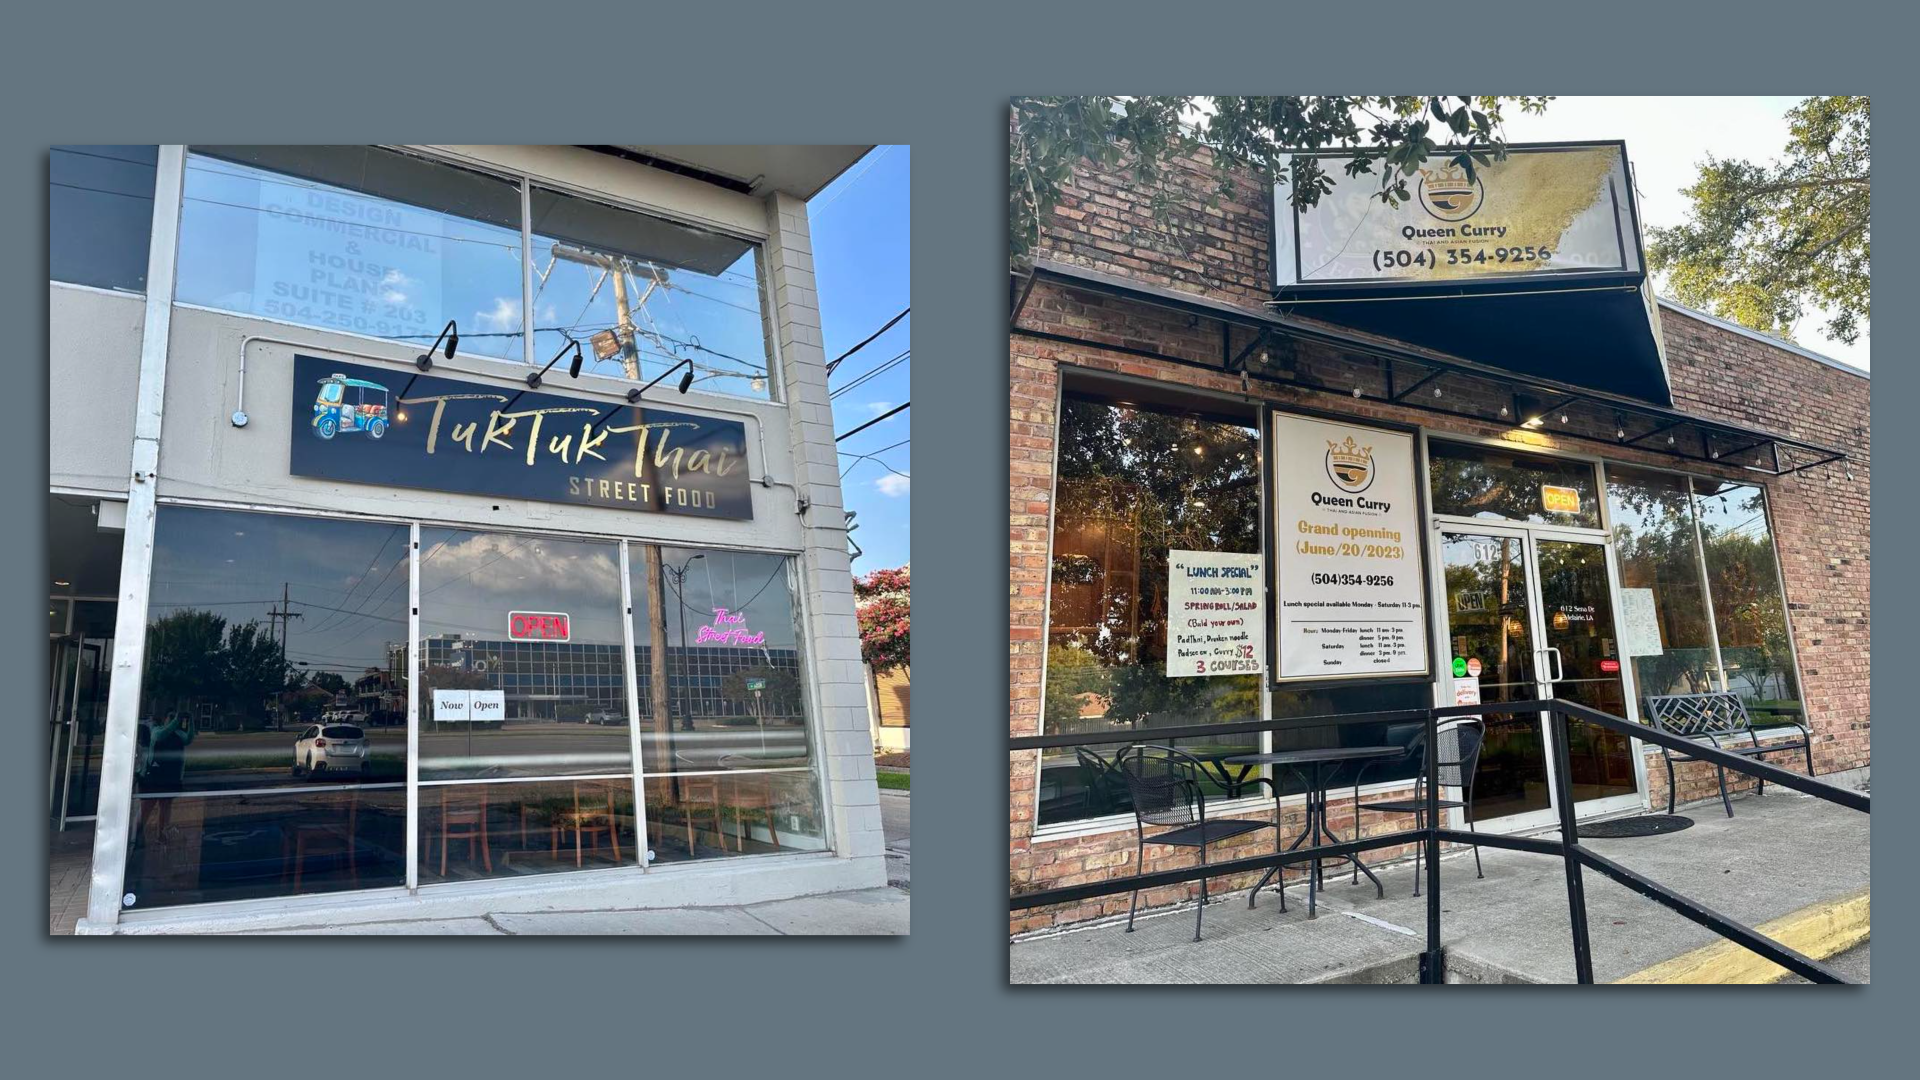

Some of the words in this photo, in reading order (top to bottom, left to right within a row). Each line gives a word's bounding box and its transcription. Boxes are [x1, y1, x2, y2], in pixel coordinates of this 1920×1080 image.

[307, 191, 400, 227] DESIGN
[266, 203, 436, 253] COMMERCIAL
[1402, 225, 1456, 240] Queen
[1460, 224, 1506, 238] Curry
[345, 241, 362, 255] &
[309, 250, 396, 279] HOUSE
[1373, 249, 1436, 272] (504)
[1447, 245, 1552, 265] 354-9256
[311, 268, 395, 297] PLANS
[273, 280, 353, 310] SUITE
[361, 299, 377, 315] #
[384, 304, 427, 324] 203
[607, 422, 737, 480] Thai
[569, 476, 650, 503] STREET
[665, 486, 716, 510] FOOD
[1311, 492, 1353, 507] Queen
[1357, 497, 1391, 513] Curry
[1547, 493, 1575, 507] OPEN
[1298, 520, 1339, 536] Grand
[1342, 526, 1401, 543] openning
[1296, 540, 1405, 560] (June/20/2023)
[1474, 543, 1498, 561] 612
[1311, 572, 1394, 587] (504)354-9256
[1191, 587, 1209, 595] 11:00
[1240, 587, 1253, 596] PM
[1184, 602, 1214, 610] SPRING
[713, 608, 745, 625] Thai
[1211, 620, 1225, 628] your
[510, 614, 568, 640] OPEN
[696, 625, 734, 644] Street
[733, 628, 766, 646] Food
[1235, 644, 1253, 659] $12
[1196, 660, 1206, 673] 3
[440, 701, 464, 711] Now
[473, 700, 500, 712] Open
